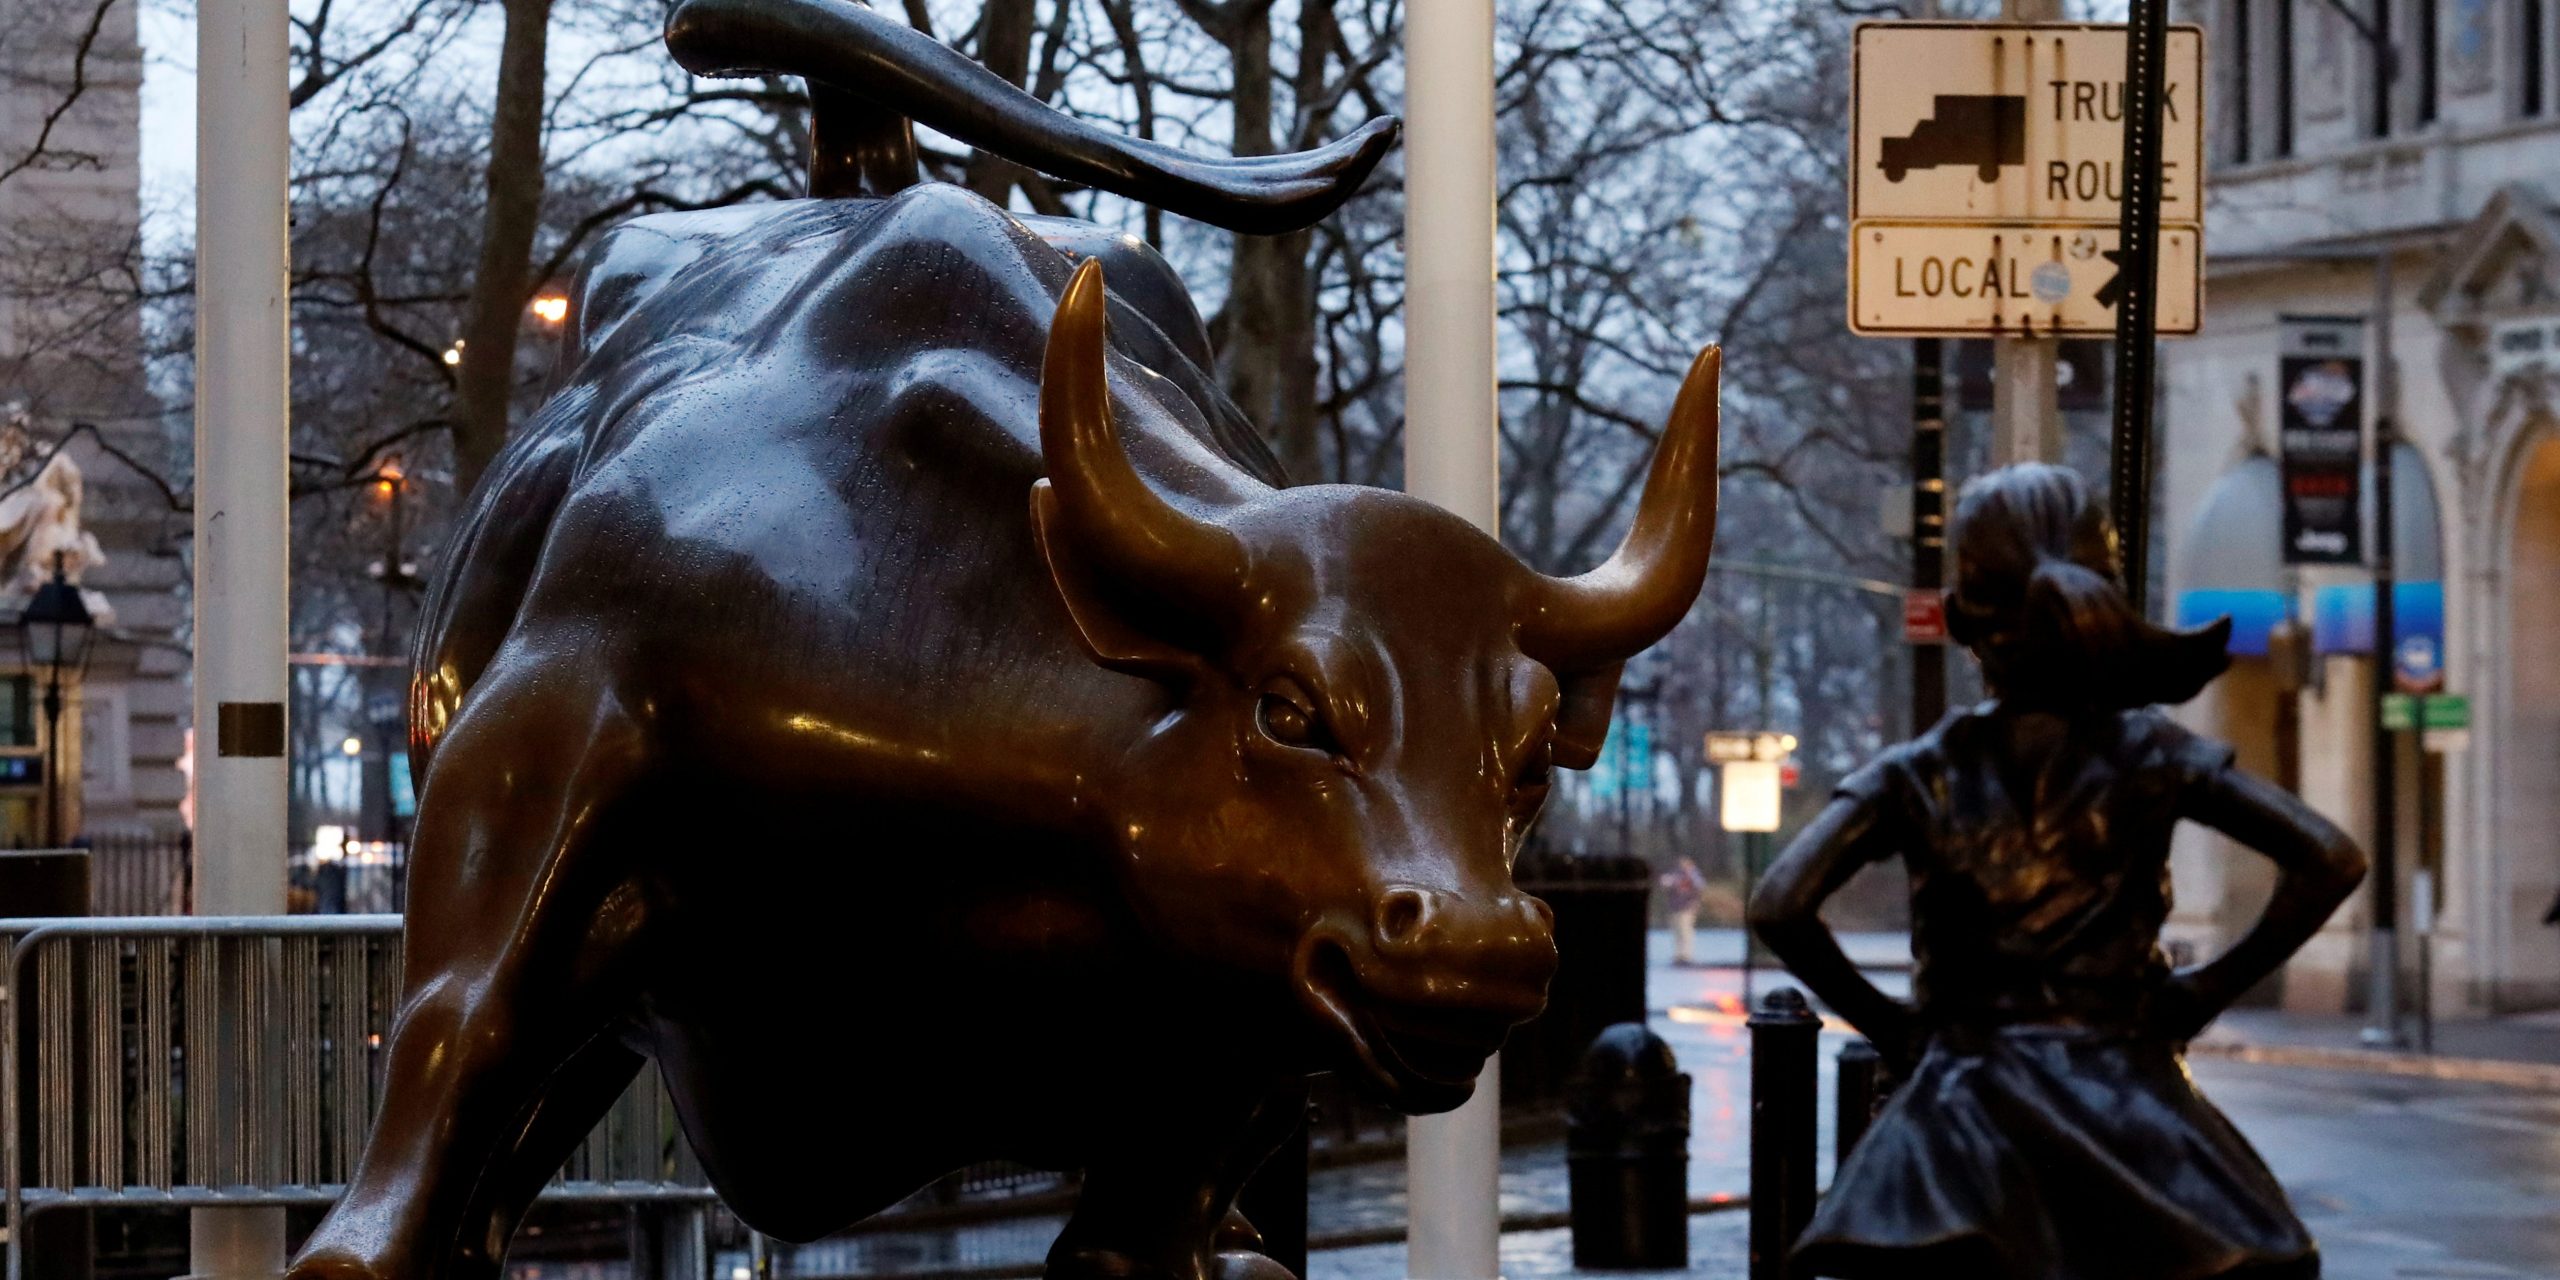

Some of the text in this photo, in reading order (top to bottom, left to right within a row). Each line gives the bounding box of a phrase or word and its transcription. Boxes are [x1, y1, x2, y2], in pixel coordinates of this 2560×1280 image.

[2048, 81, 2179, 122] TRUK
[2047, 160, 2178, 202] ROUE
[1895, 257, 2030, 299] LOCAL
